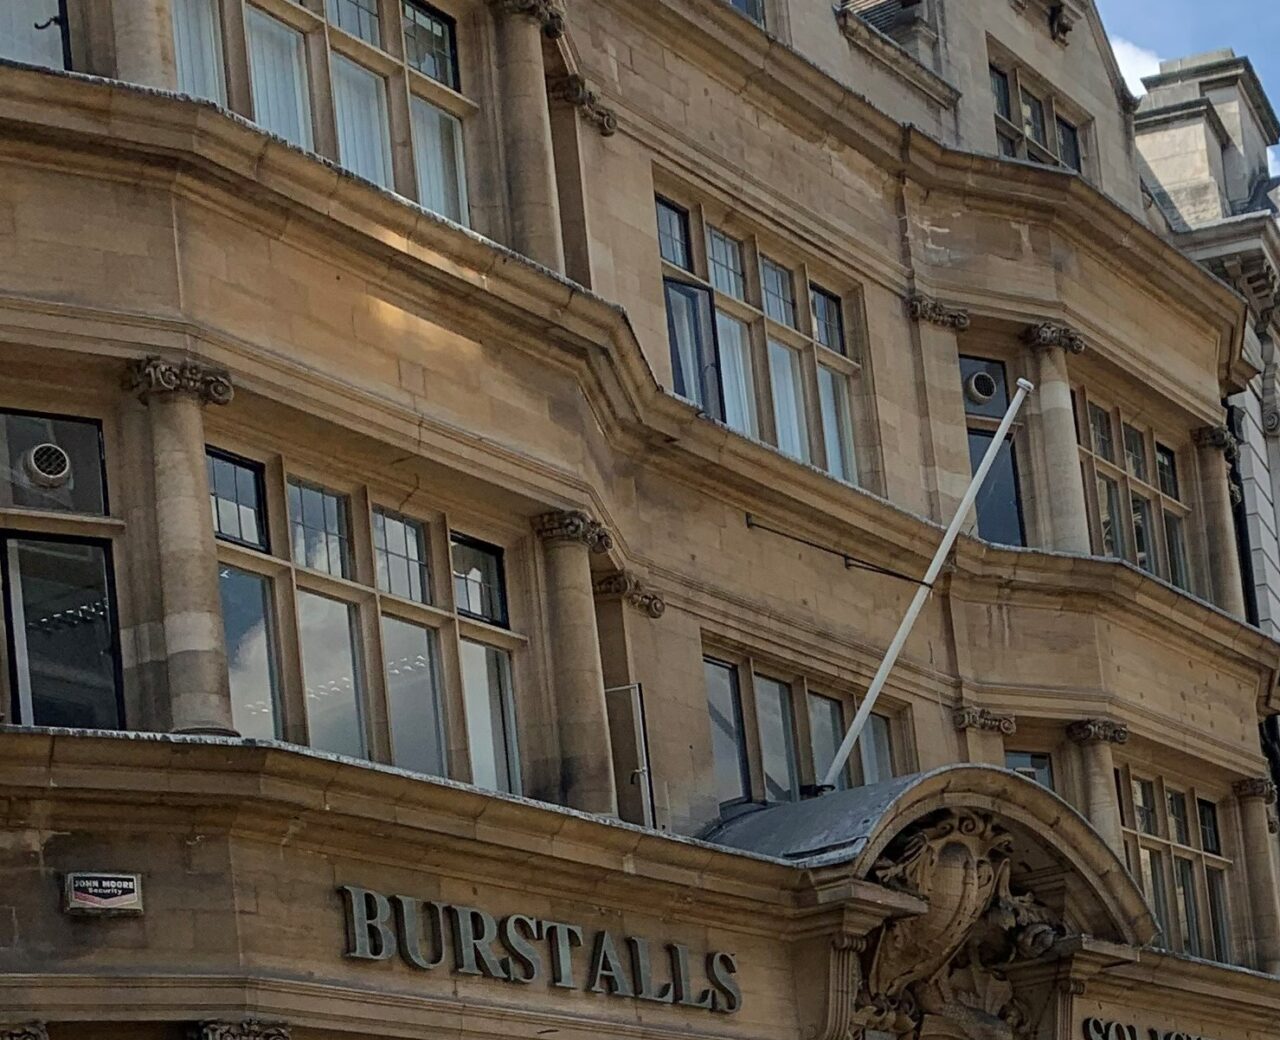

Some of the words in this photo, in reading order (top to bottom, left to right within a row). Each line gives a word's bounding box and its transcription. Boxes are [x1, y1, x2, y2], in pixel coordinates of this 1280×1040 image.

[74, 880, 99, 888] JOHN
[102, 880, 134, 889] MOORE
[88, 887, 122, 895] Security
[341, 885, 743, 1015] BURSTALLS
